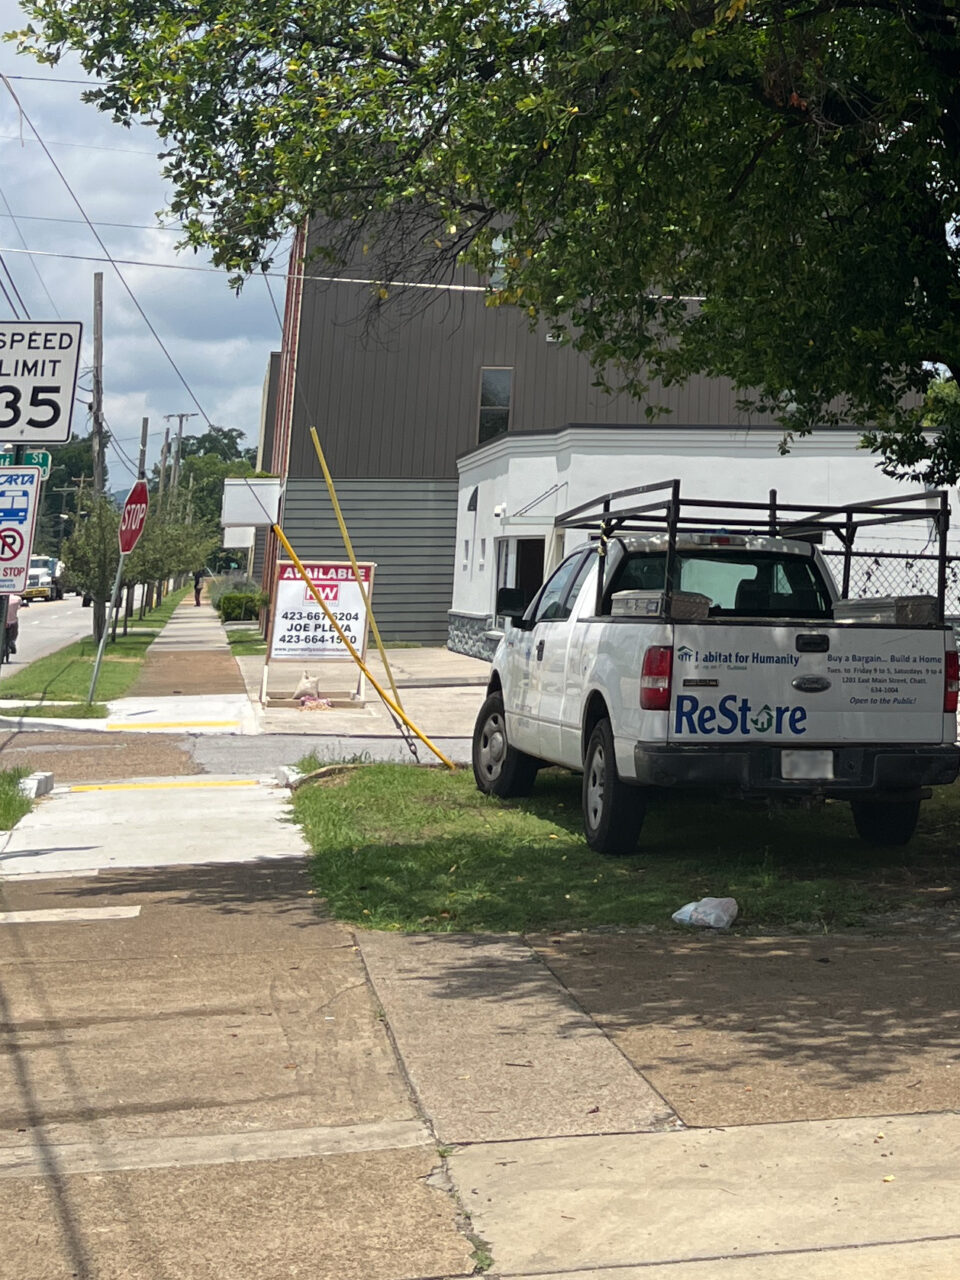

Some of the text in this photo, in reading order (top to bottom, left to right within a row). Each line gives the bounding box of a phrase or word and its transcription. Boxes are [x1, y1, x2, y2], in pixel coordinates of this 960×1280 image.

[0, 359, 62, 377] LIMIT
[0, 385, 61, 429] 35
[121, 503, 147, 532] STOP
[2, 566, 26, 578] STOP
[283, 567, 366, 579] AVAILABLE
[286, 623, 311, 632] JOE
[279, 635, 357, 644] 423-664-150
[735, 652, 750, 663] for
[751, 652, 800, 668] Humanity
[827, 654, 843, 663] Buy
[890, 654, 911, 663] Build
[918, 655, 943, 664] Home
[853, 667, 873, 675] Friday
[849, 696, 917, 706] Open to the Public!
[675, 694, 808, 734] ReStore
